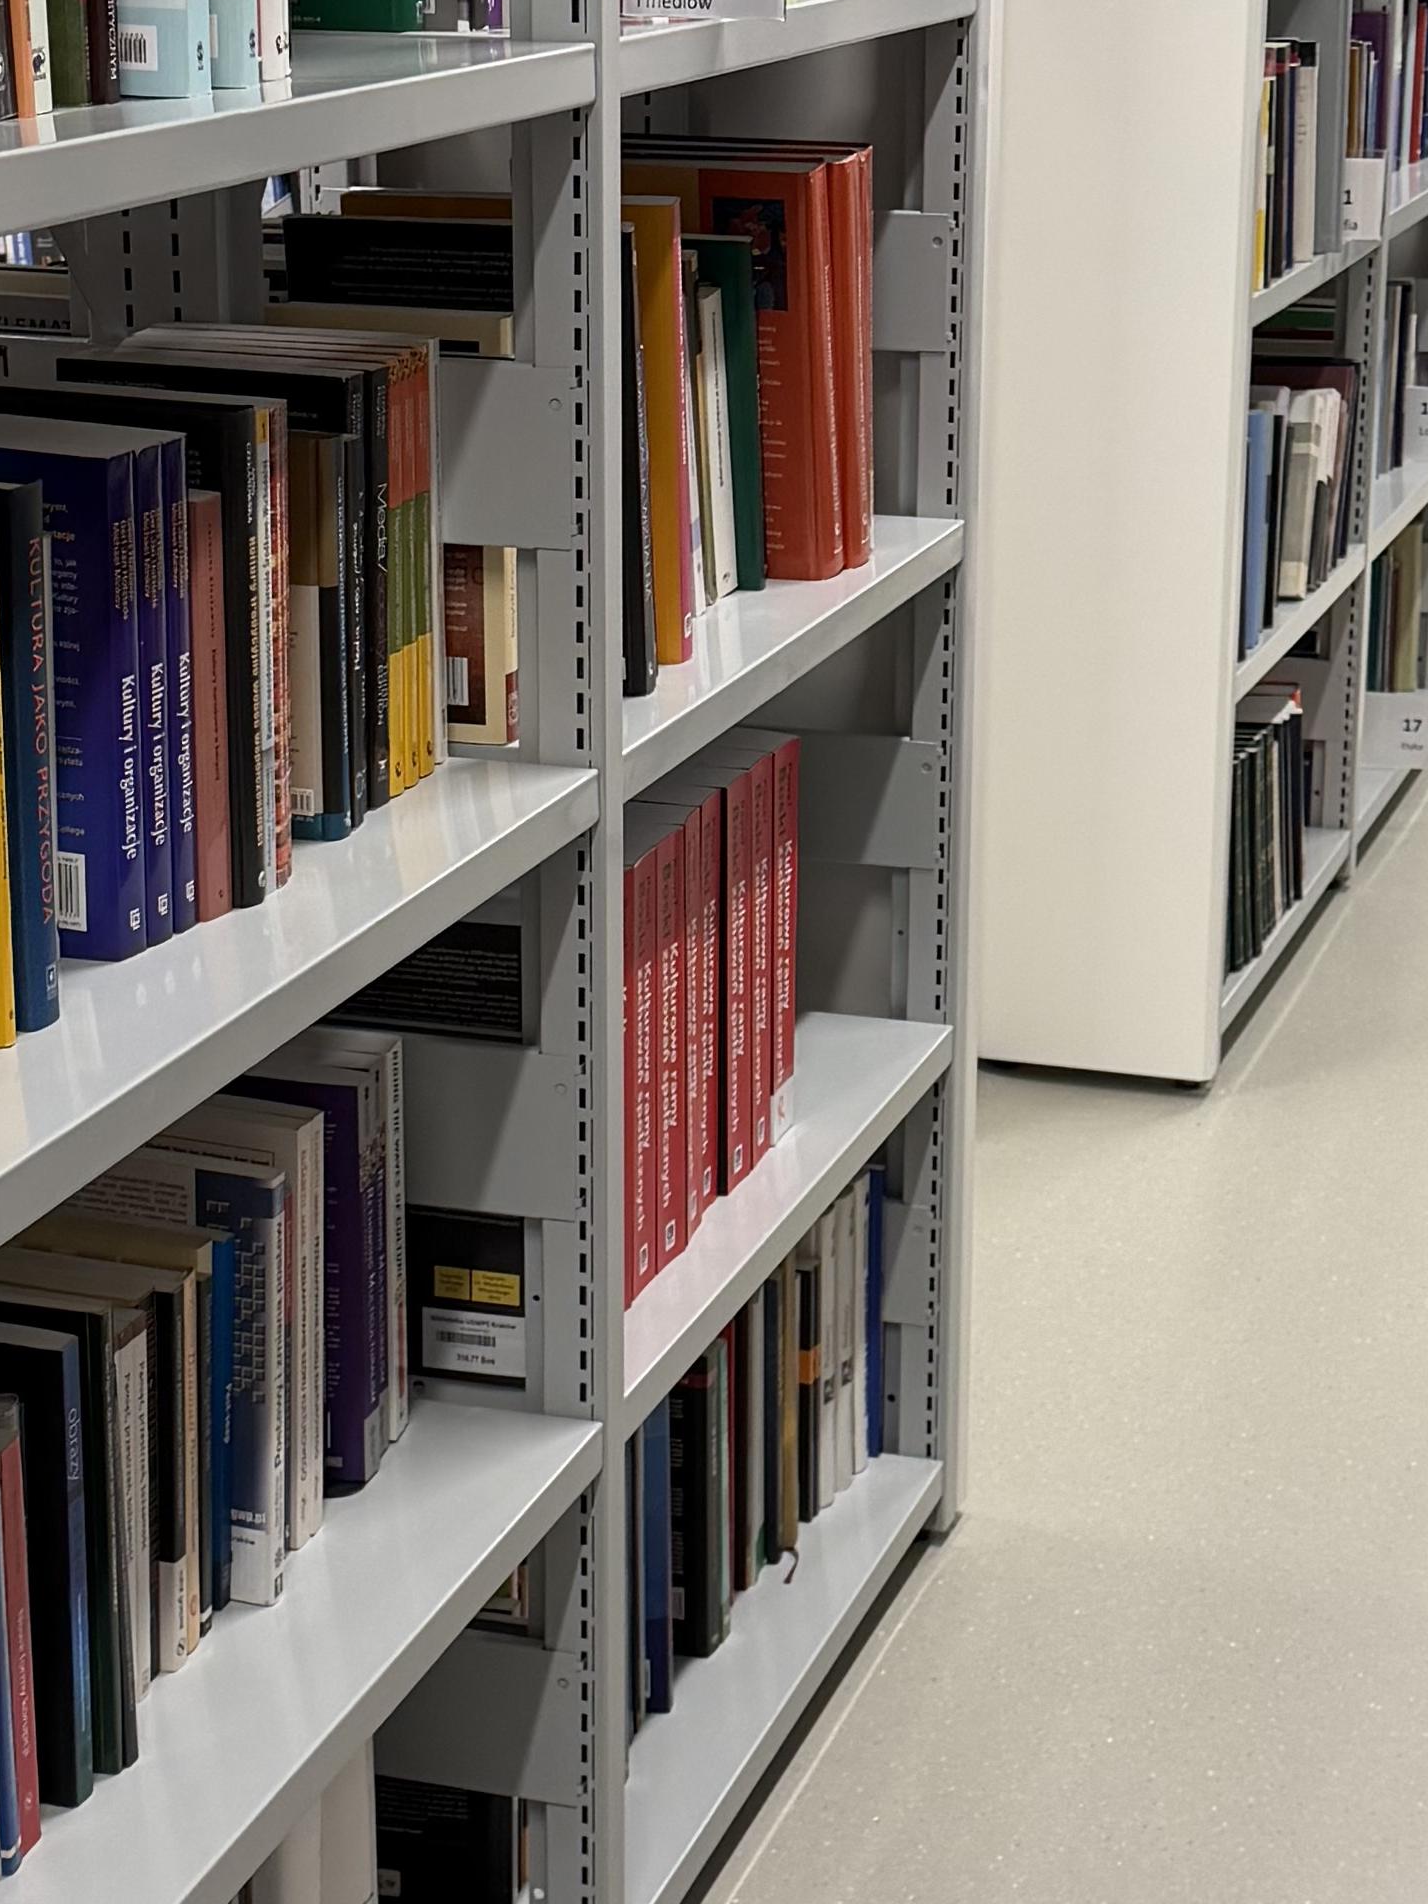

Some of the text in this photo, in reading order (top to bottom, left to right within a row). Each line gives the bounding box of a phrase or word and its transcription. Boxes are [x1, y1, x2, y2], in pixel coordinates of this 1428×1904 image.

[27, 537, 54, 926] KULTURA JAKO PRZYGODA
[119, 673, 136, 742] Kultury
[1402, 718, 1423, 733] 17
[119, 756, 140, 861] organizacje
